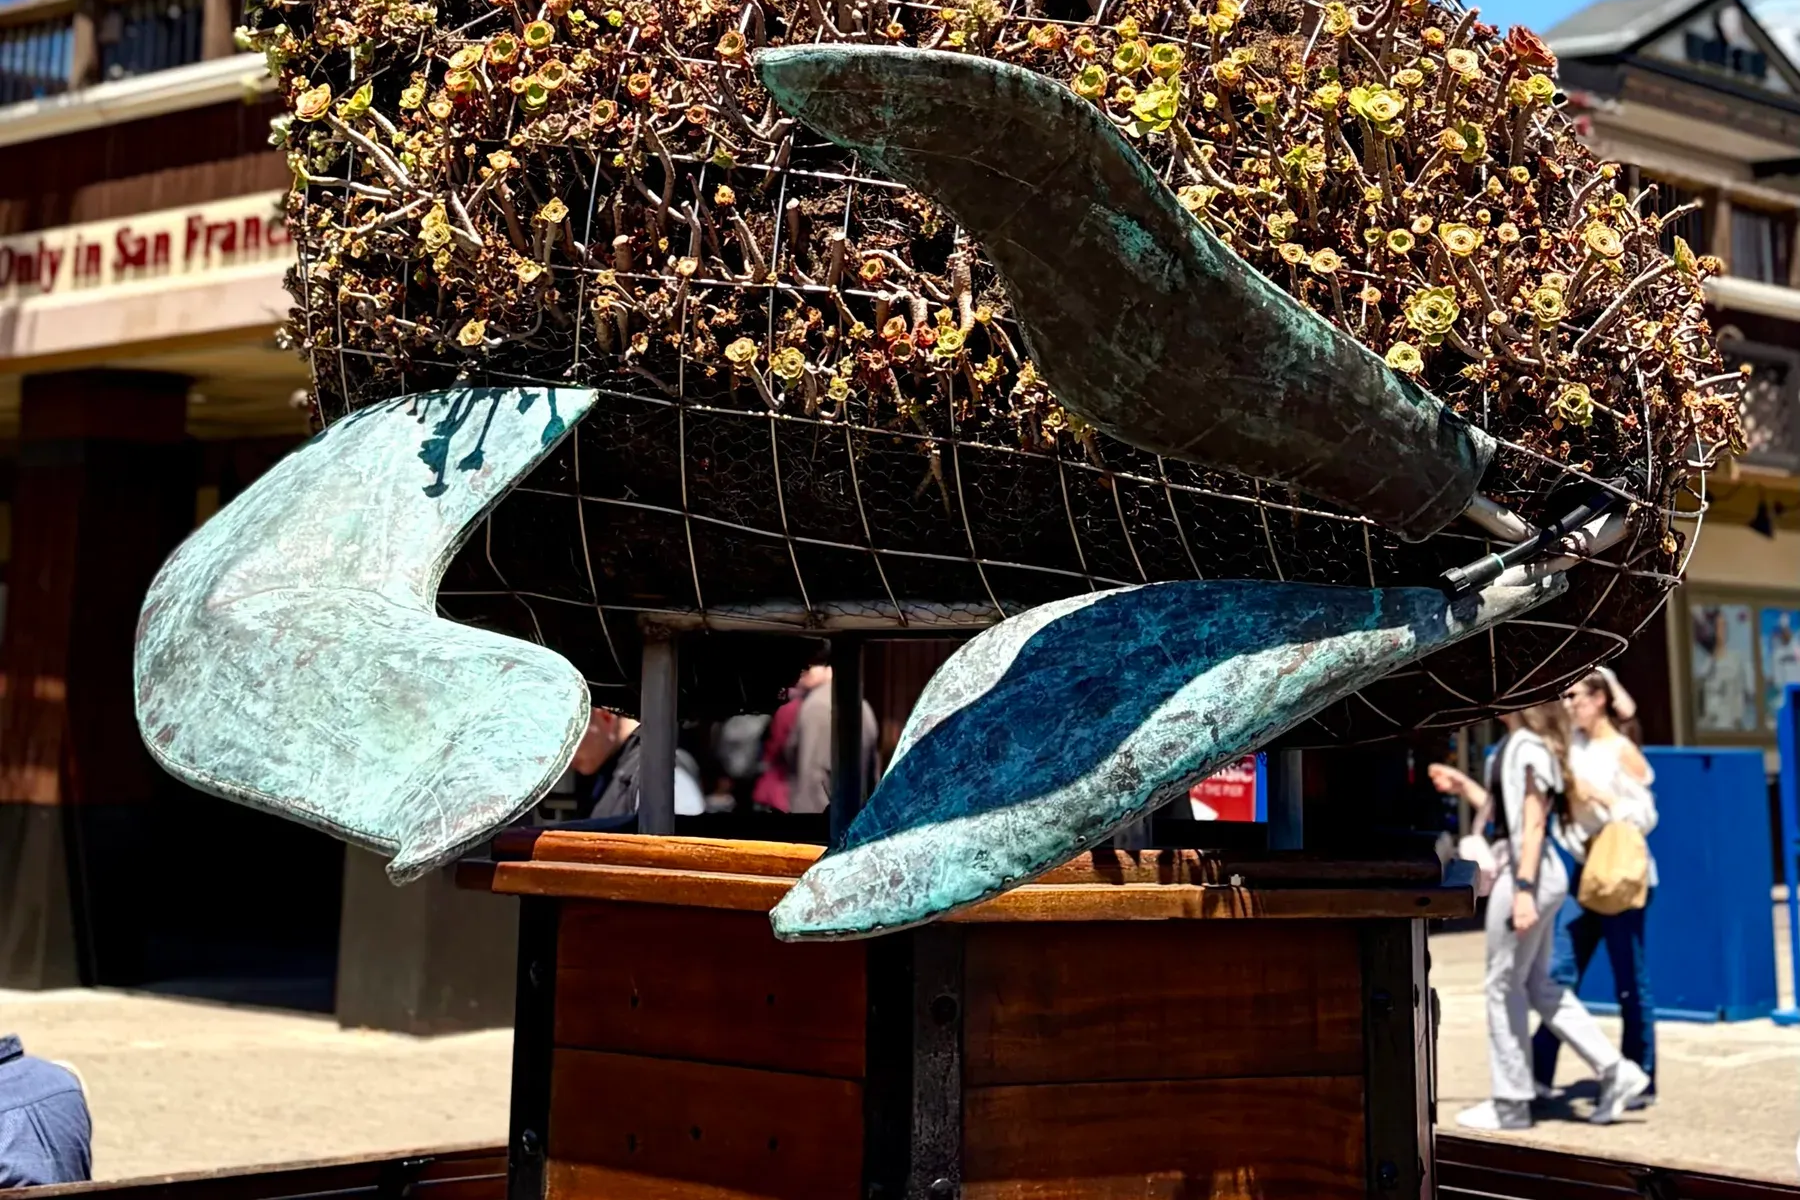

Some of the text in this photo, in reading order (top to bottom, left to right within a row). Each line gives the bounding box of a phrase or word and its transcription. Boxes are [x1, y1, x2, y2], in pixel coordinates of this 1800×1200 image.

[0, 240, 64, 293] Only
[74, 235, 102, 279] in
[114, 225, 170, 272] San
